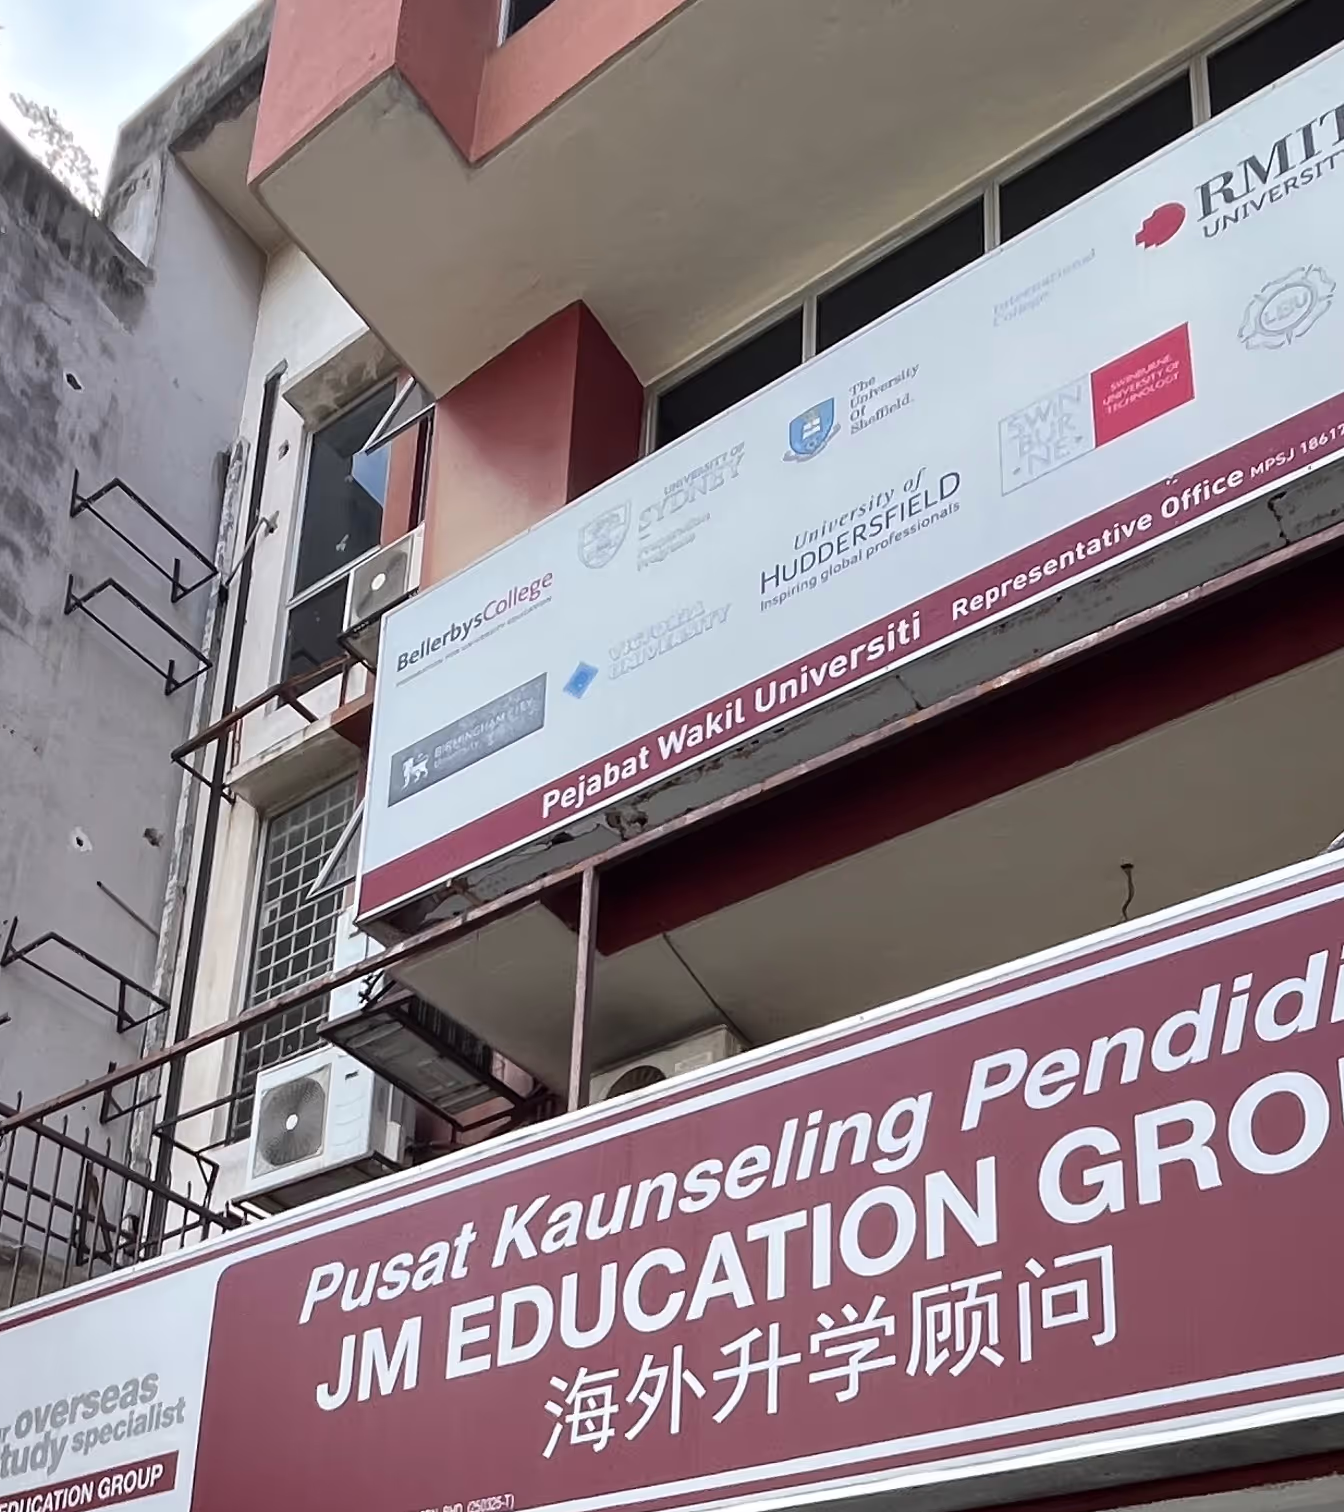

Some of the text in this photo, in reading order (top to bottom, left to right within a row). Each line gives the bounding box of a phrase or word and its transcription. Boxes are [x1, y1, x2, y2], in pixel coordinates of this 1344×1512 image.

[849, 375, 877, 397] The
[850, 364, 920, 410] University
[637, 455, 746, 534] SYDNEY
[760, 471, 962, 595] HUDDERSFIELD
[794, 467, 928, 551] University of
[759, 501, 962, 612] Inspiring global professionals
[396, 571, 554, 673] BellerbysCollege
[541, 744, 650, 819] Pejabat
[657, 697, 746, 762] Wakil
[754, 610, 921, 713] Universiti
[951, 501, 1153, 620] Representative
[1159, 463, 1245, 519] Office
[1250, 447, 1295, 479] MPSJ
[298, 1221, 477, 1325] Pusat
[490, 1090, 933, 1271] Kaunseling
[315, 1315, 423, 1413] JM
[445, 1156, 999, 1382] EDUCATION
[541, 1243, 1119, 1459] 海外升学顾问
[14, 1372, 161, 1441] overseas
[71, 1396, 188, 1456] specialist
[97, 1462, 165, 1502] GROUP
